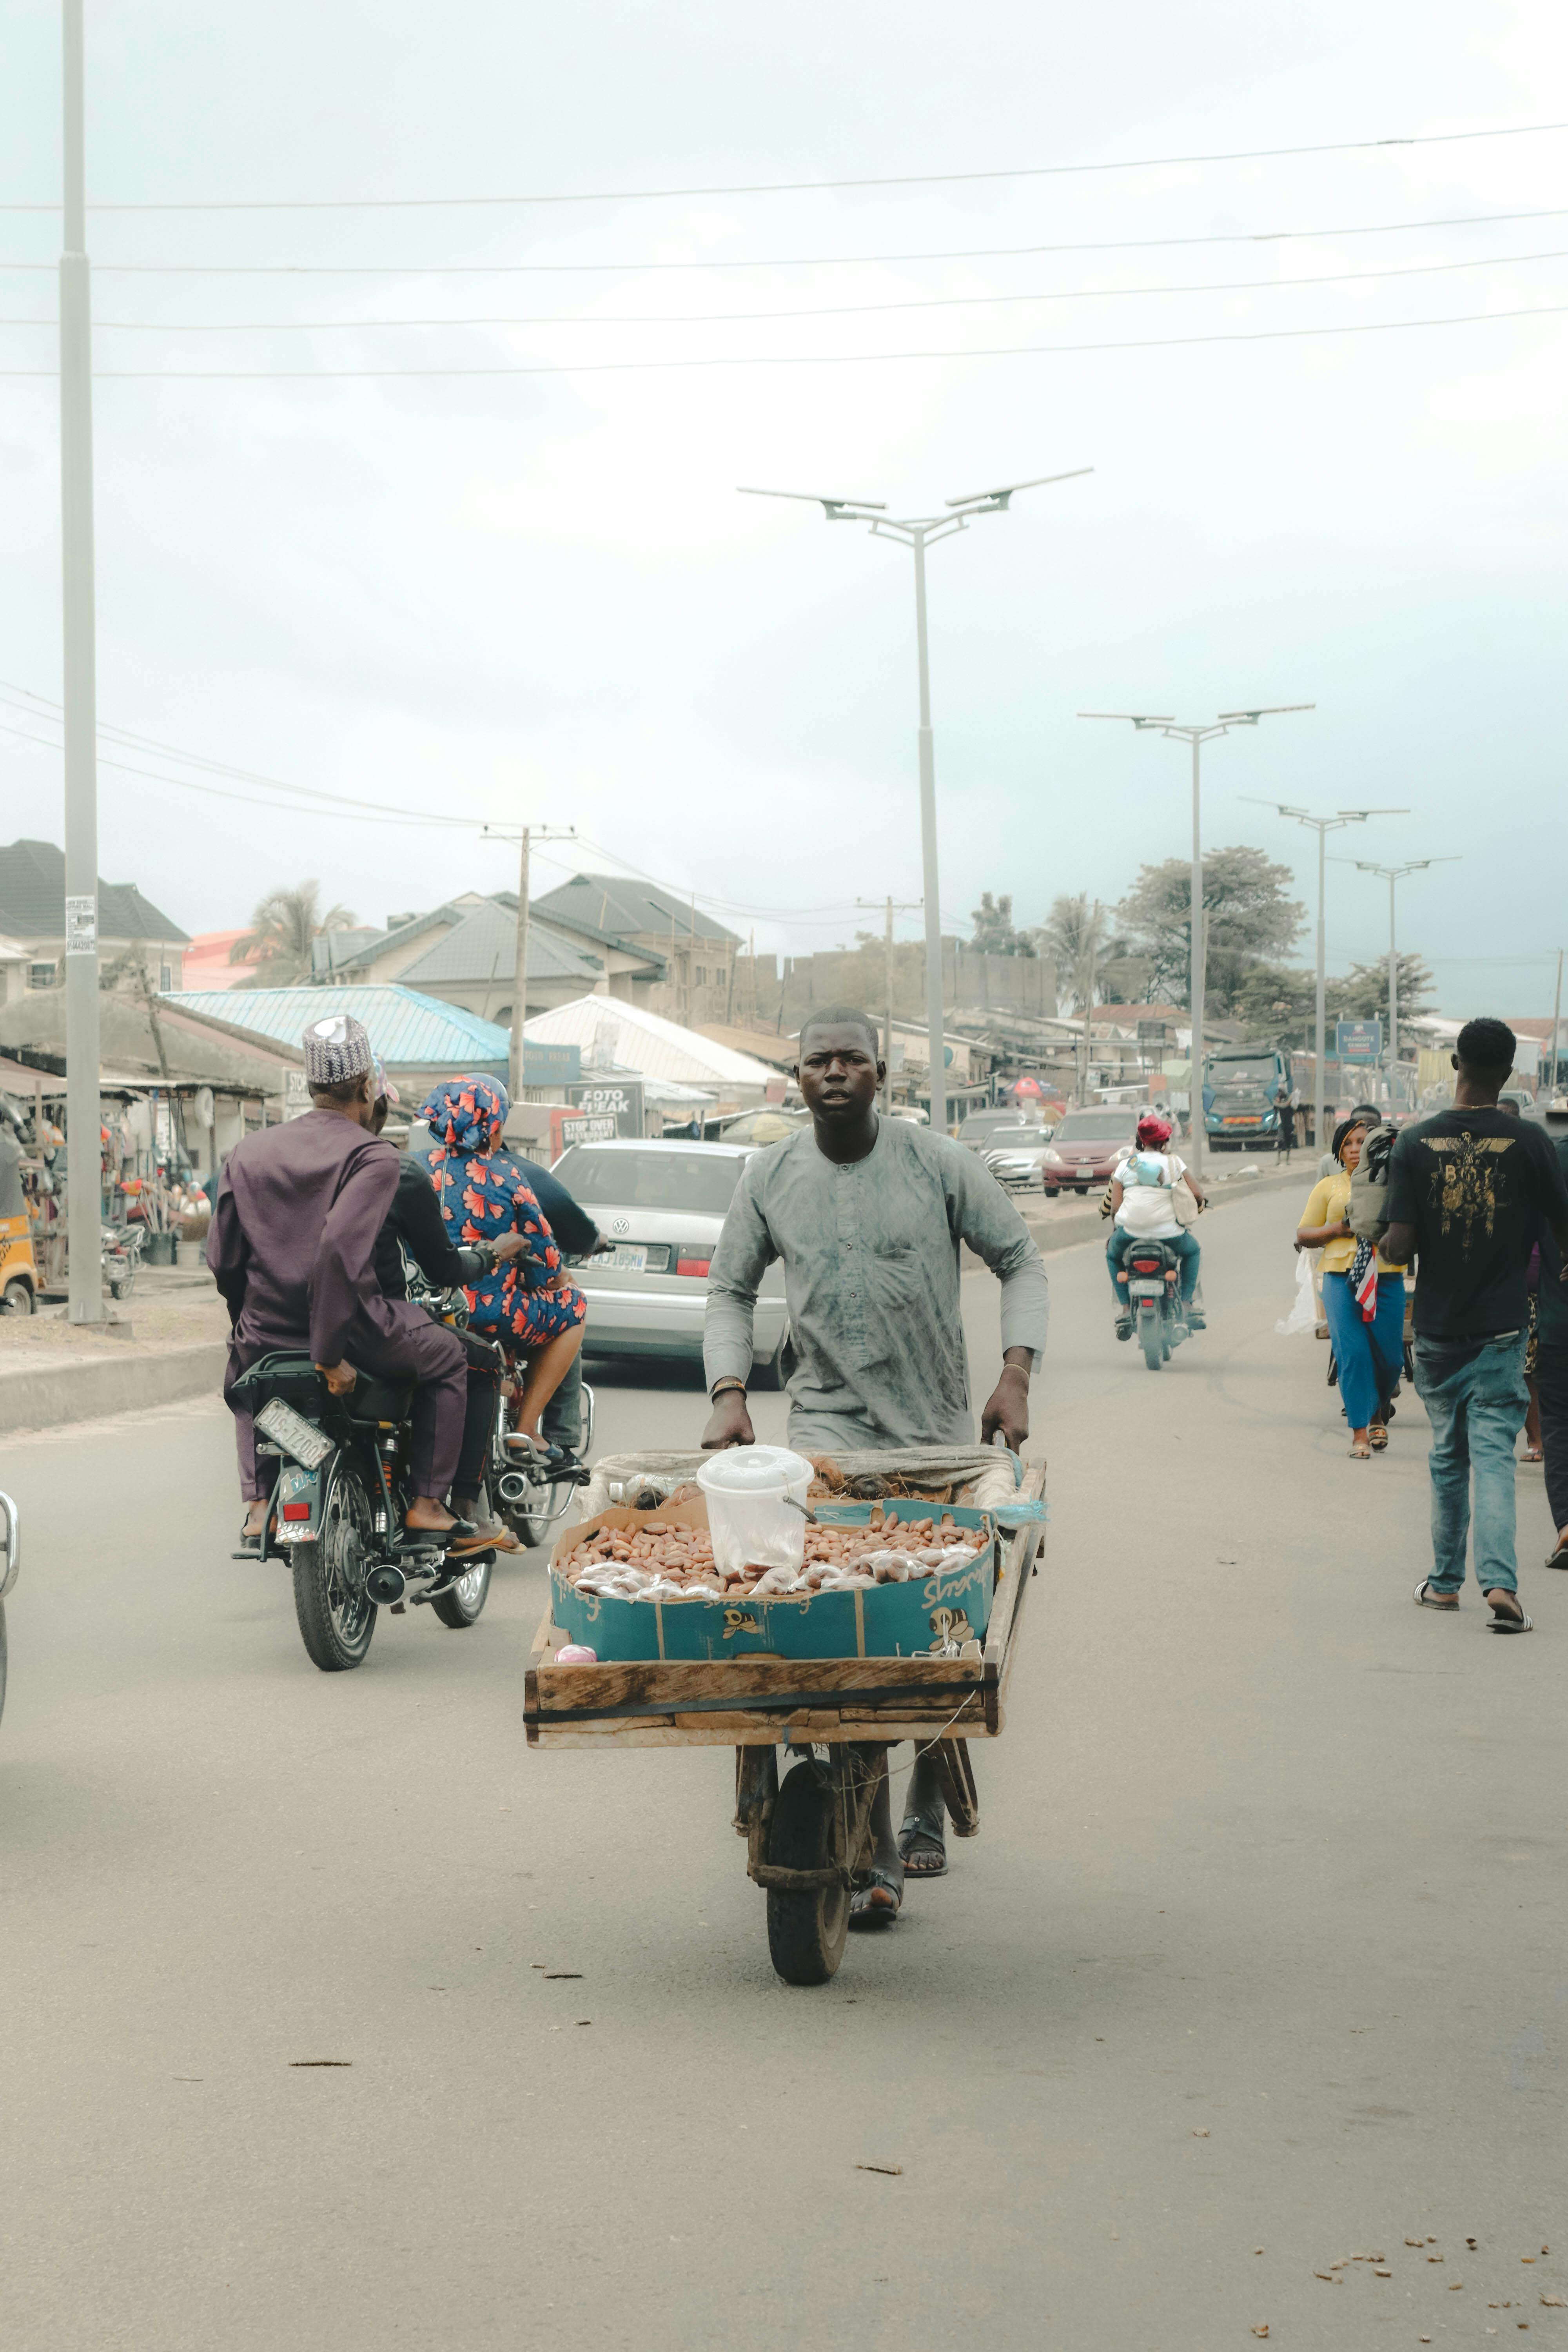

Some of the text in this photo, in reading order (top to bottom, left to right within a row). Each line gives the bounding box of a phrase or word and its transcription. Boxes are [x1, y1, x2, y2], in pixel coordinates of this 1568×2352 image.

[583, 1089, 624, 1101] FOTO
[564, 1118, 615, 1132] STOP OVER
